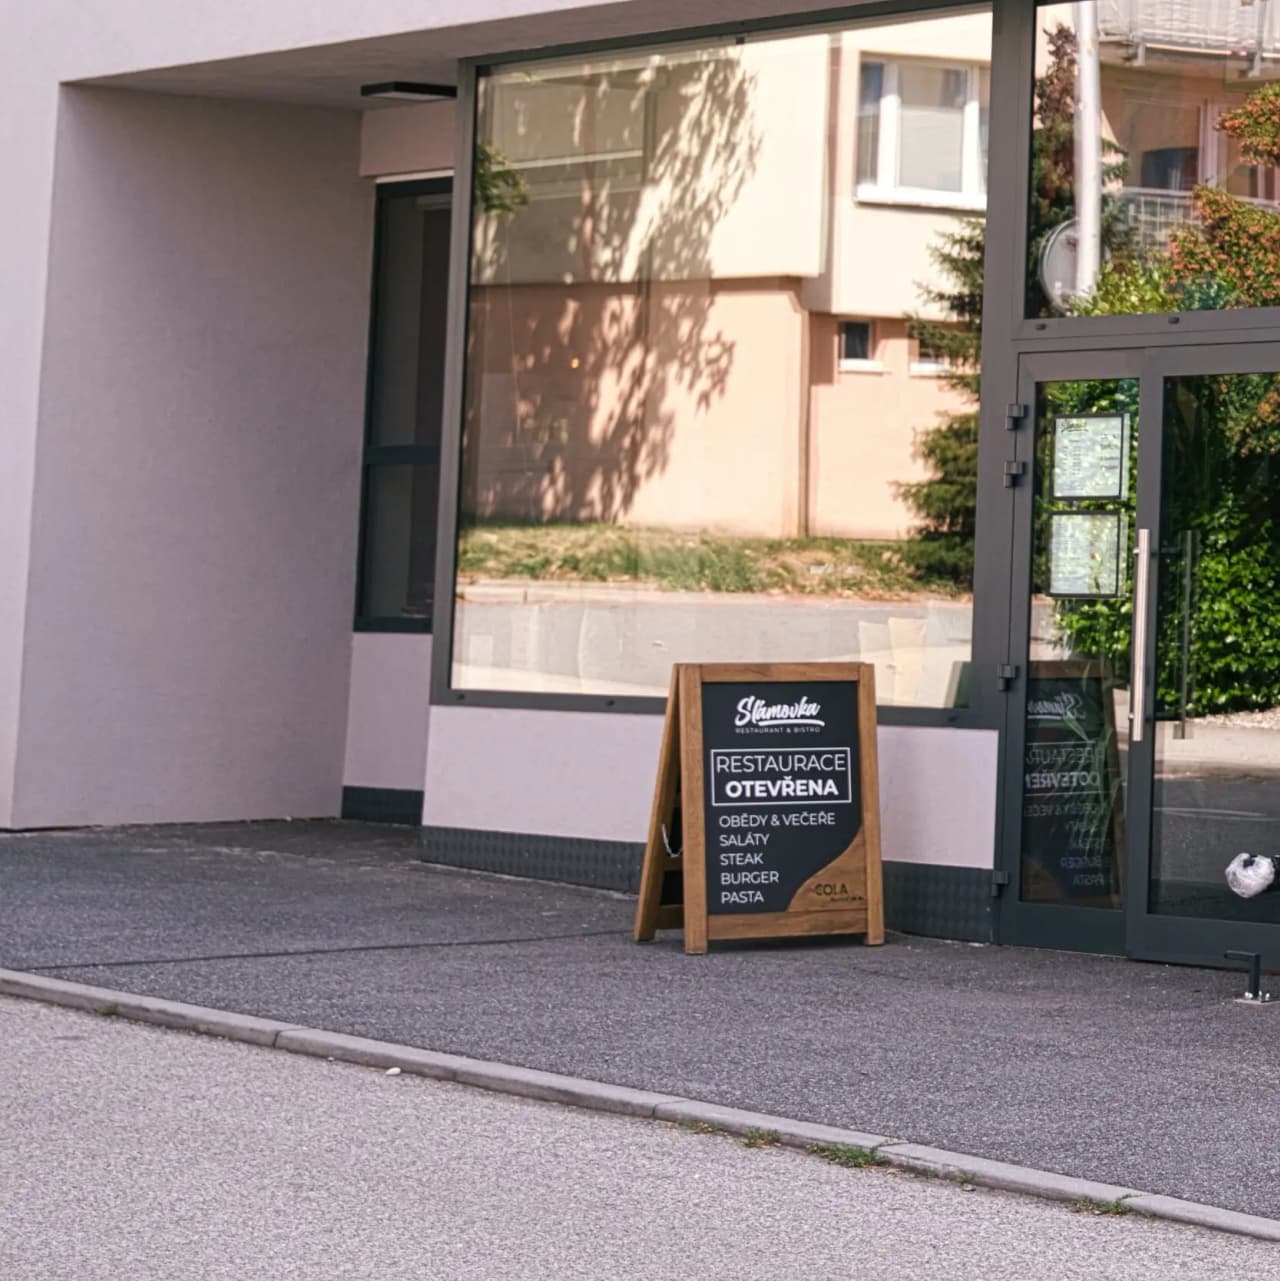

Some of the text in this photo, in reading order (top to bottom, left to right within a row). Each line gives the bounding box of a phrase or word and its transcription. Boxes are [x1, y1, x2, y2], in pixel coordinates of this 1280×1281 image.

[716, 753, 847, 773] RESTAURACE
[725, 775, 840, 798] OTEVŘENA
[719, 811, 836, 828] OBĚDY & VEČEŘE
[719, 832, 770, 847] SALÁTY
[719, 852, 764, 866] STEAK
[720, 871, 780, 885] BURGER
[721, 890, 765, 904] PASTA
